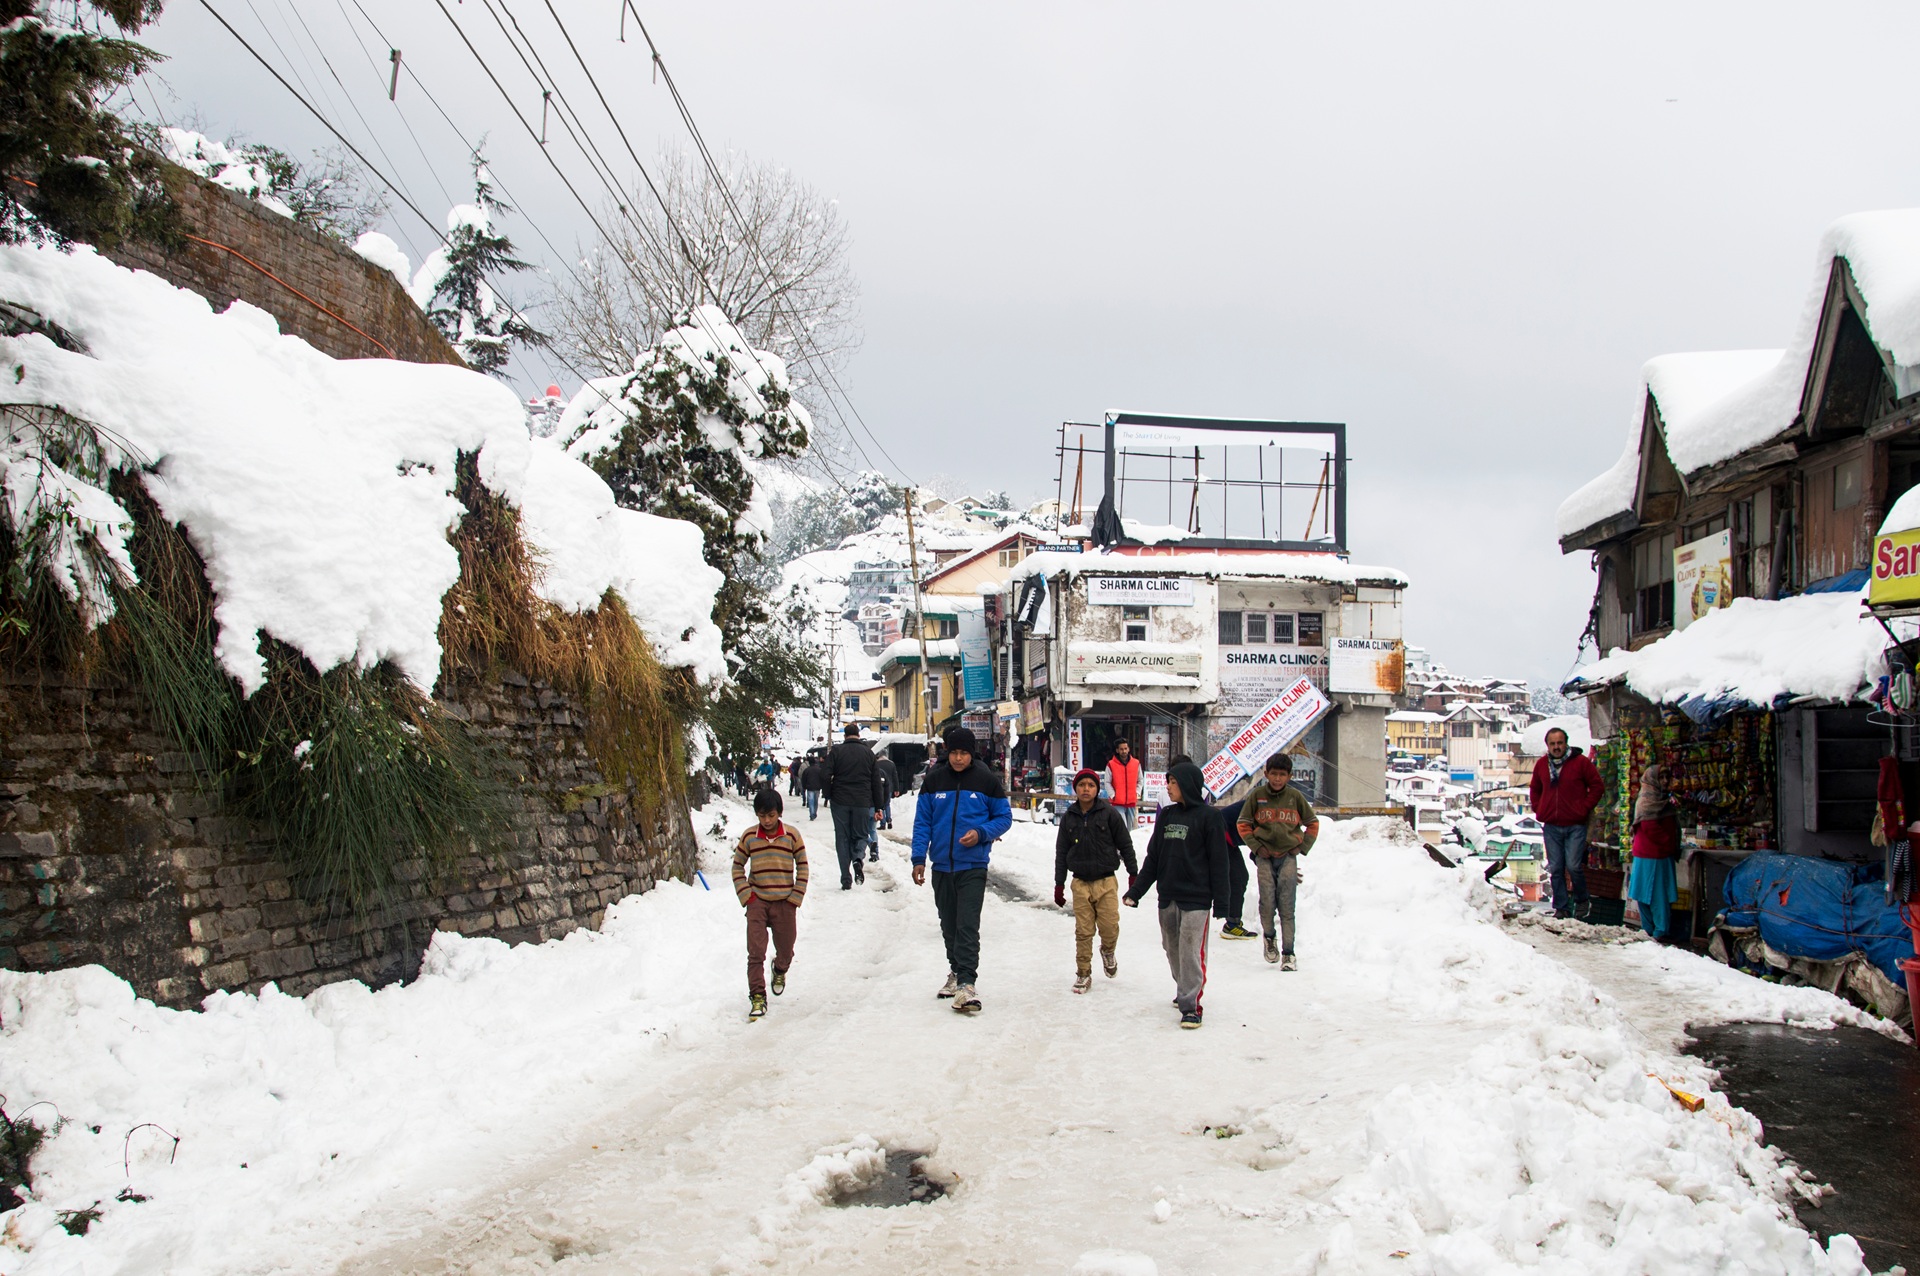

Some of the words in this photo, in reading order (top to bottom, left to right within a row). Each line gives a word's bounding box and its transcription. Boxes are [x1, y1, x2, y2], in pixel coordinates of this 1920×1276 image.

[1677, 568, 1696, 583] CLOVE
[1100, 579, 1143, 590] SHARMA
[1146, 580, 1180, 591] CLINIC
[1338, 639, 1370, 649] SHARMA
[1372, 640, 1395, 651] CLINIC
[1095, 655, 1138, 665] SHARMA
[1141, 656, 1174, 665] CLINIC
[1226, 653, 1276, 664] SHARMA
[1280, 654, 1317, 665] CLINIC
[1284, 667, 1297, 675] TEST
[1228, 728, 1256, 755] INDER
[1251, 701, 1286, 734] DENTAL
[1281, 678, 1311, 707] CLINIC
[1251, 740, 1266, 754] DEEPA
[1283, 712, 1297, 726] DENTAL
[1296, 697, 1314, 714] SURGEON
[1201, 754, 1224, 775] INDER
[1202, 768, 1220, 784] DENTAL
[1217, 756, 1233, 771] CLINIC
[1209, 776, 1226, 792] IMPLANT
[1224, 763, 1240, 779] CENTRE
